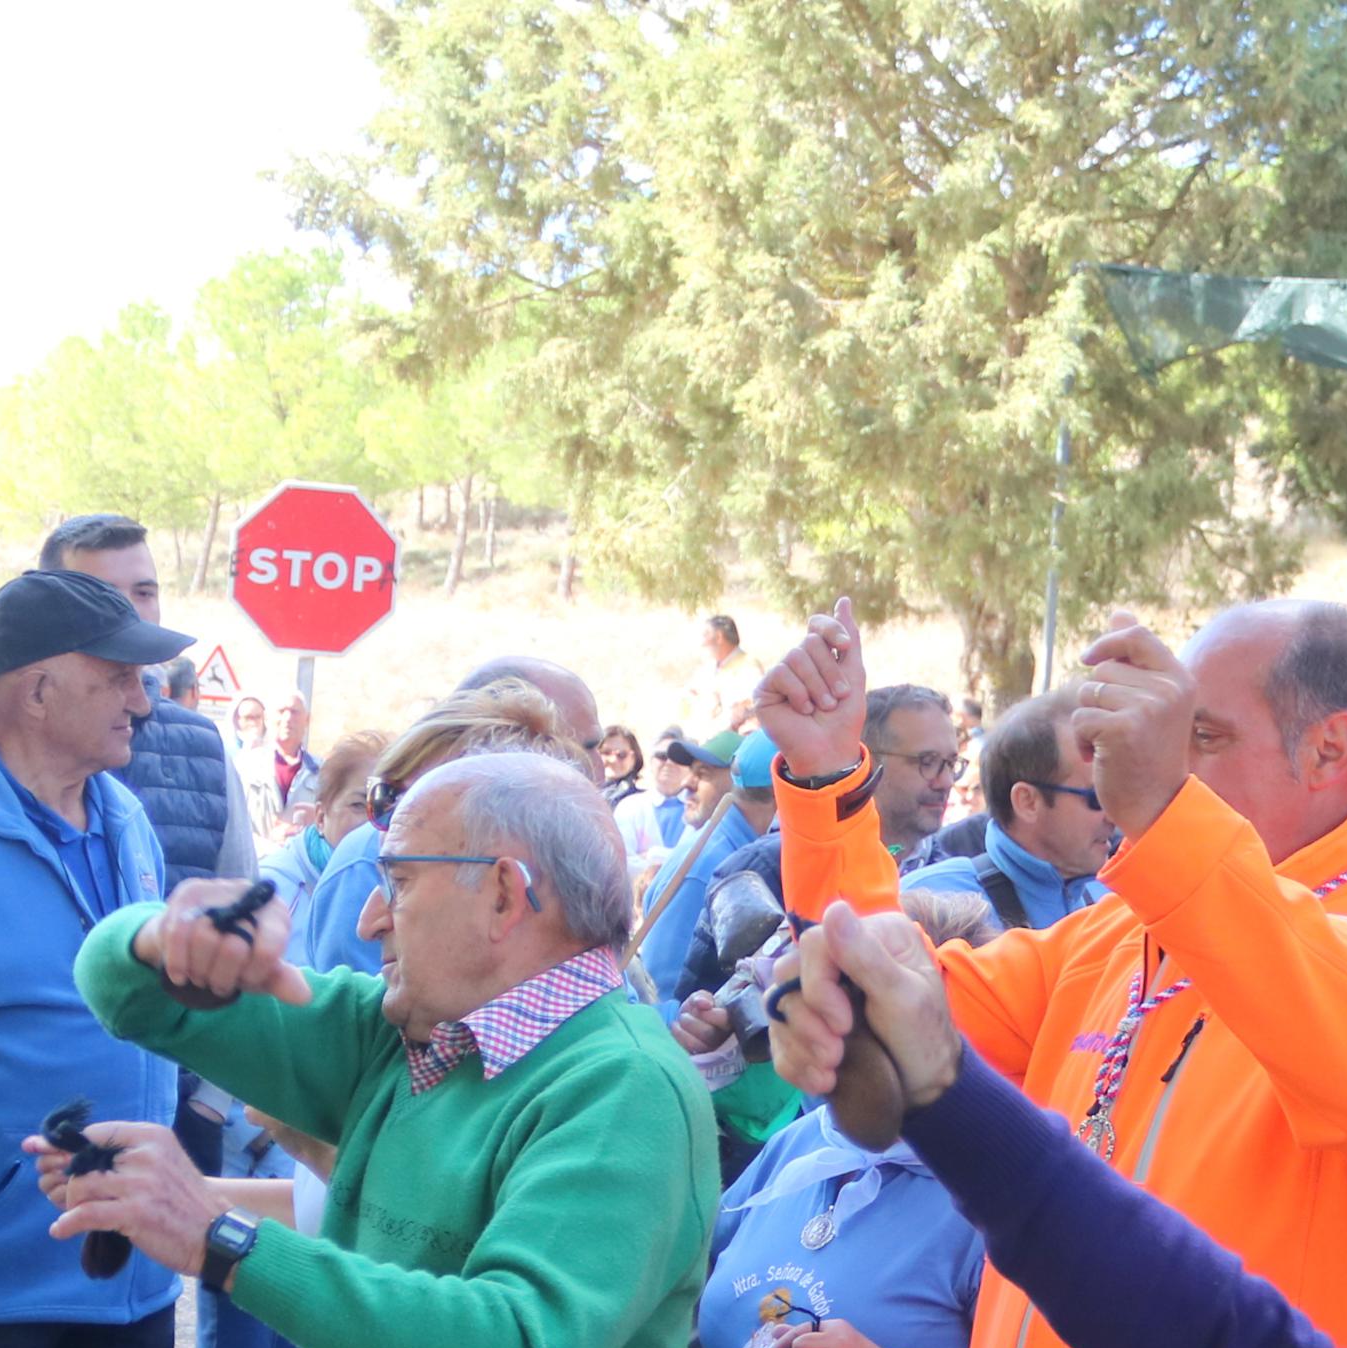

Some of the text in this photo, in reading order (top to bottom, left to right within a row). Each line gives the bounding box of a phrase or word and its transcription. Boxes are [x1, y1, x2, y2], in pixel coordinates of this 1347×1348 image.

[247, 547, 383, 593] STOP
[733, 1273, 762, 1298] Ntra.
[765, 1262, 804, 1283] Señora
[798, 1269, 815, 1289] de
